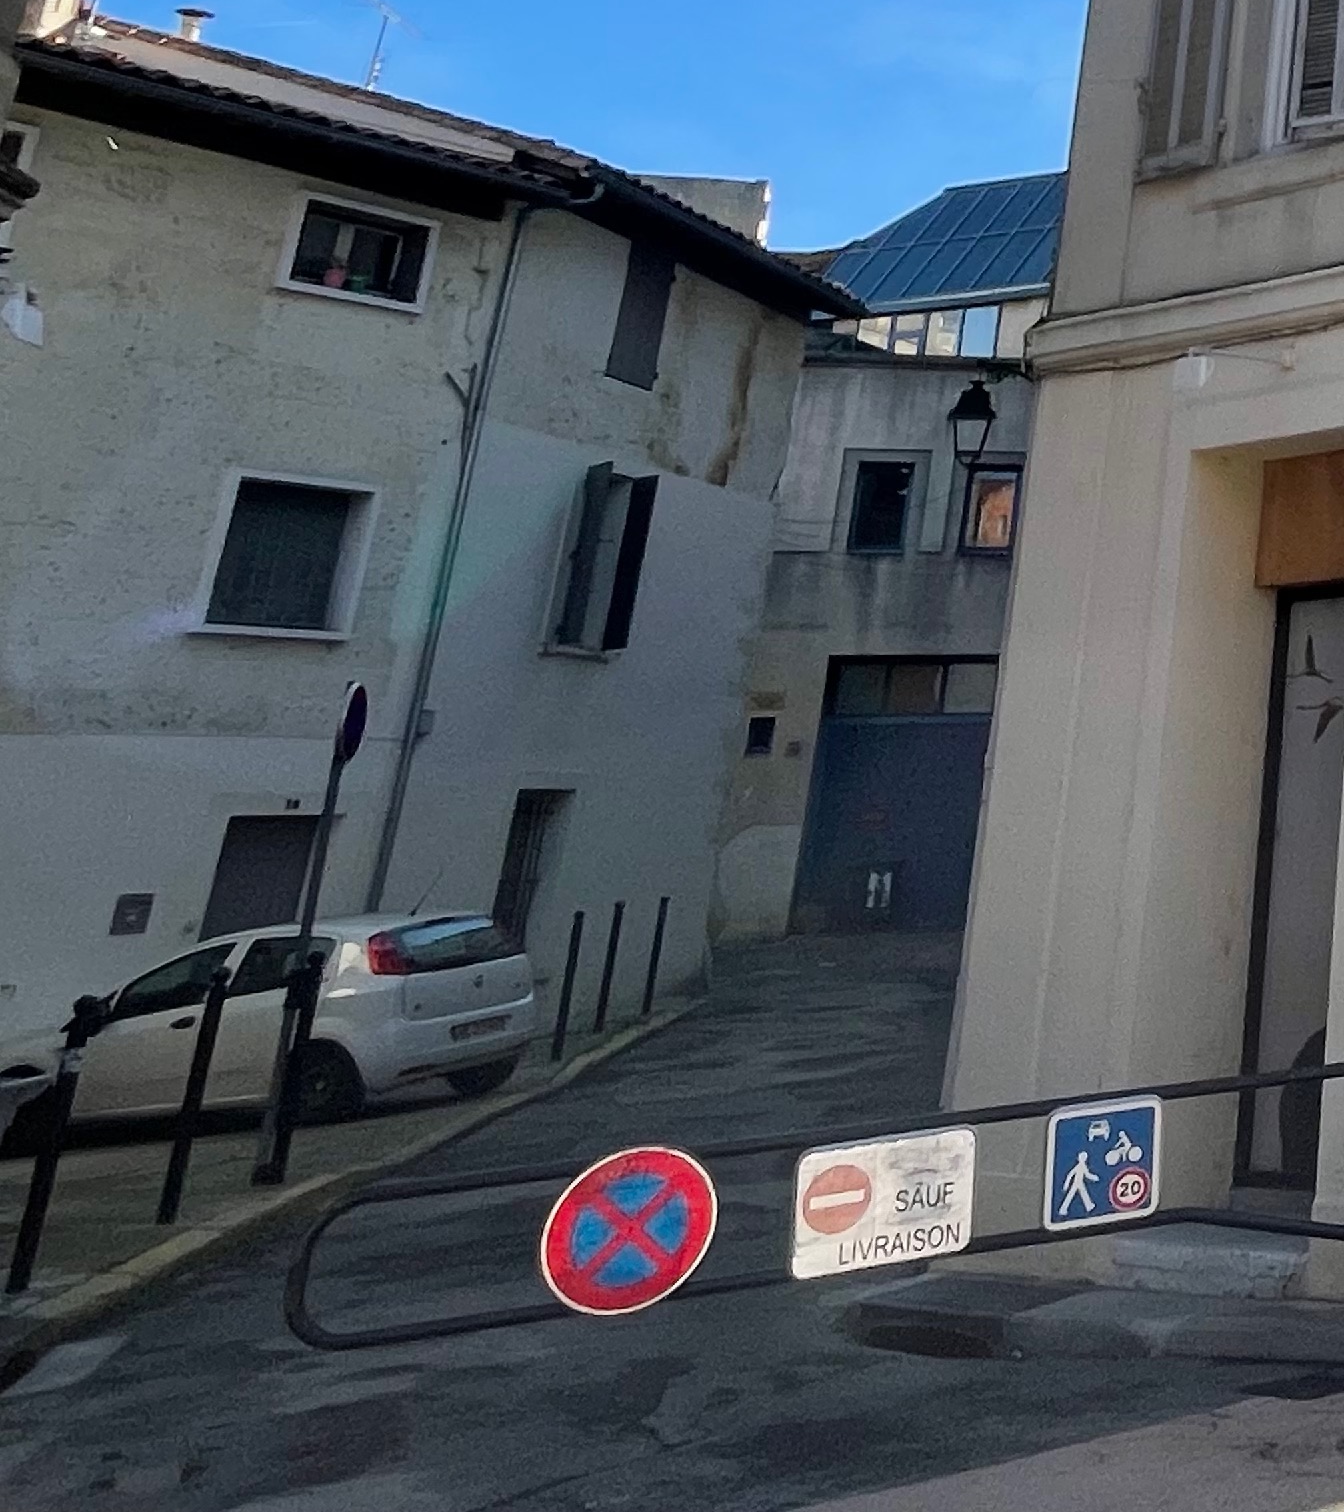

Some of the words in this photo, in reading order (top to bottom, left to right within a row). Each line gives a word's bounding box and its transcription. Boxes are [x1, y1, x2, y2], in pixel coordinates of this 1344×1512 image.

[894, 1181, 955, 1213] SAUF
[1119, 1180, 1141, 1198] 20
[838, 1221, 961, 1266] LIVRAISON
